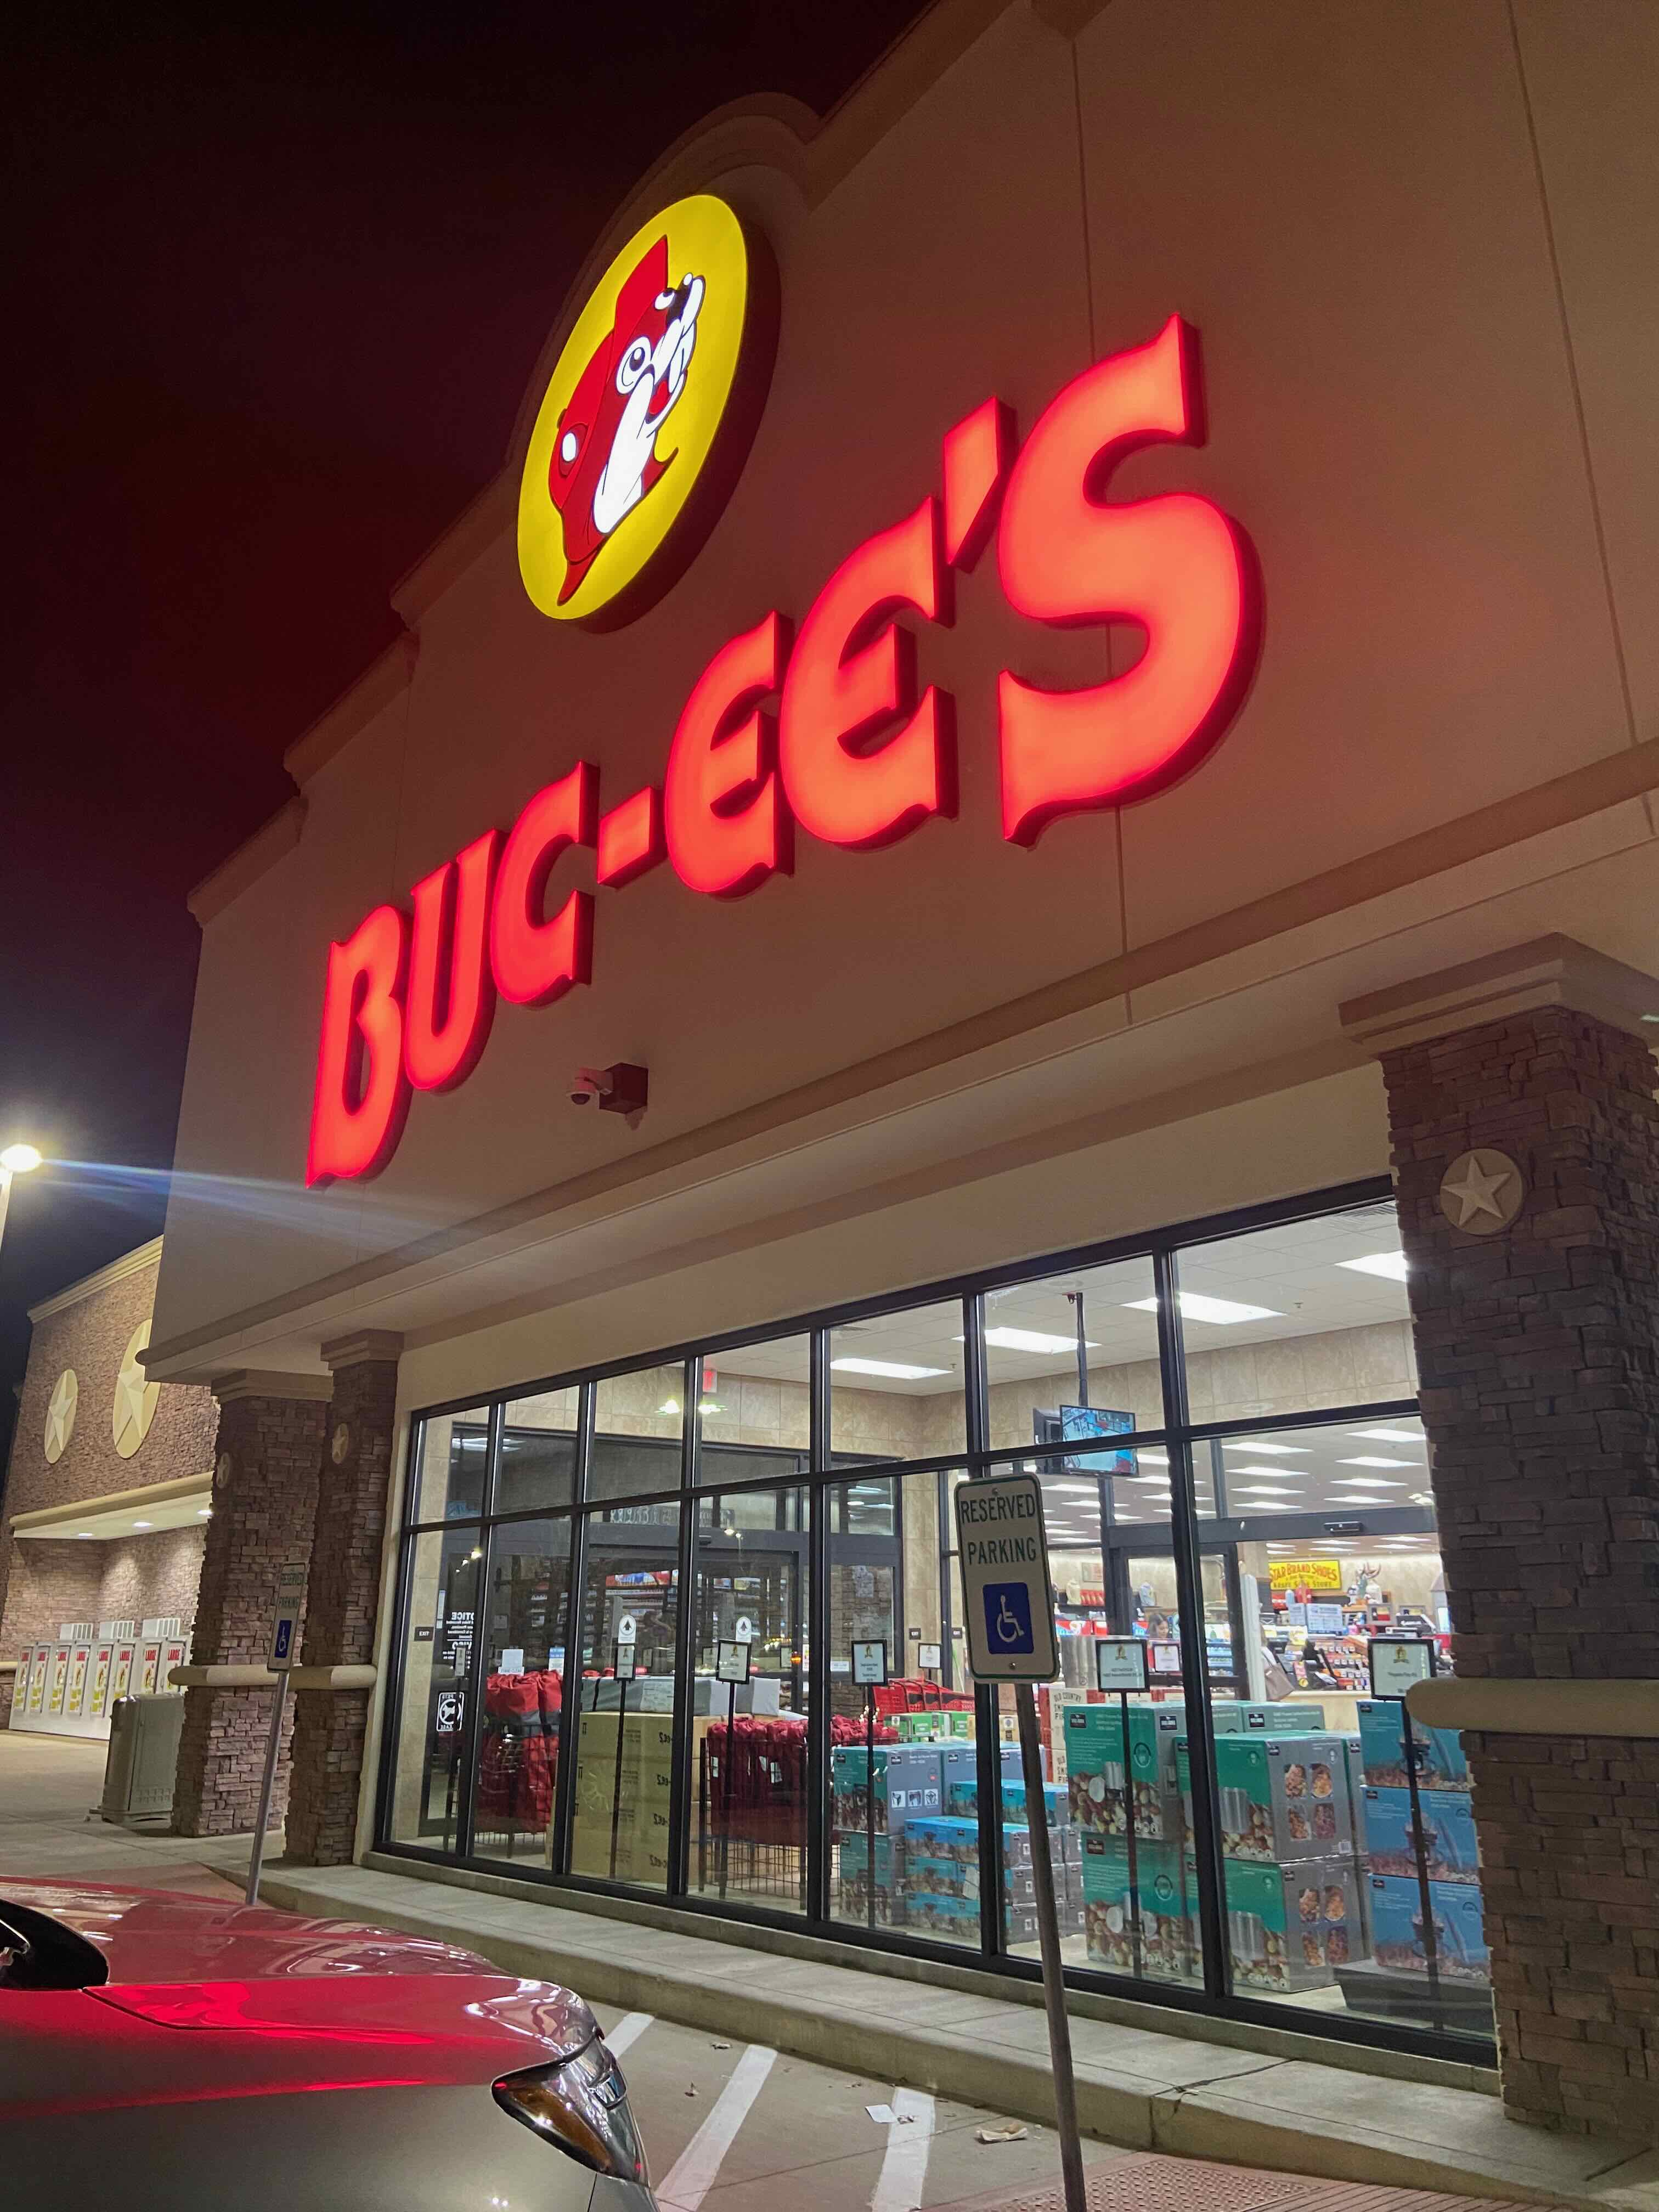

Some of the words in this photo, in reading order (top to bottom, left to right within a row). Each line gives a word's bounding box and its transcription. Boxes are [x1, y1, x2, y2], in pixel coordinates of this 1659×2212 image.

[306, 313, 1266, 1188] BUC-EE'S
[961, 1493, 1036, 1523] RESERVED
[968, 1537, 1036, 1565] PARKING
[1286, 1564, 1311, 1576] BRAND
[1311, 1564, 1338, 1581] SHOES
[145, 1649, 157, 1661] LARGE
[167, 1649, 180, 1661] LARGE
[1062, 1692, 1082, 1702] COUNTRY
